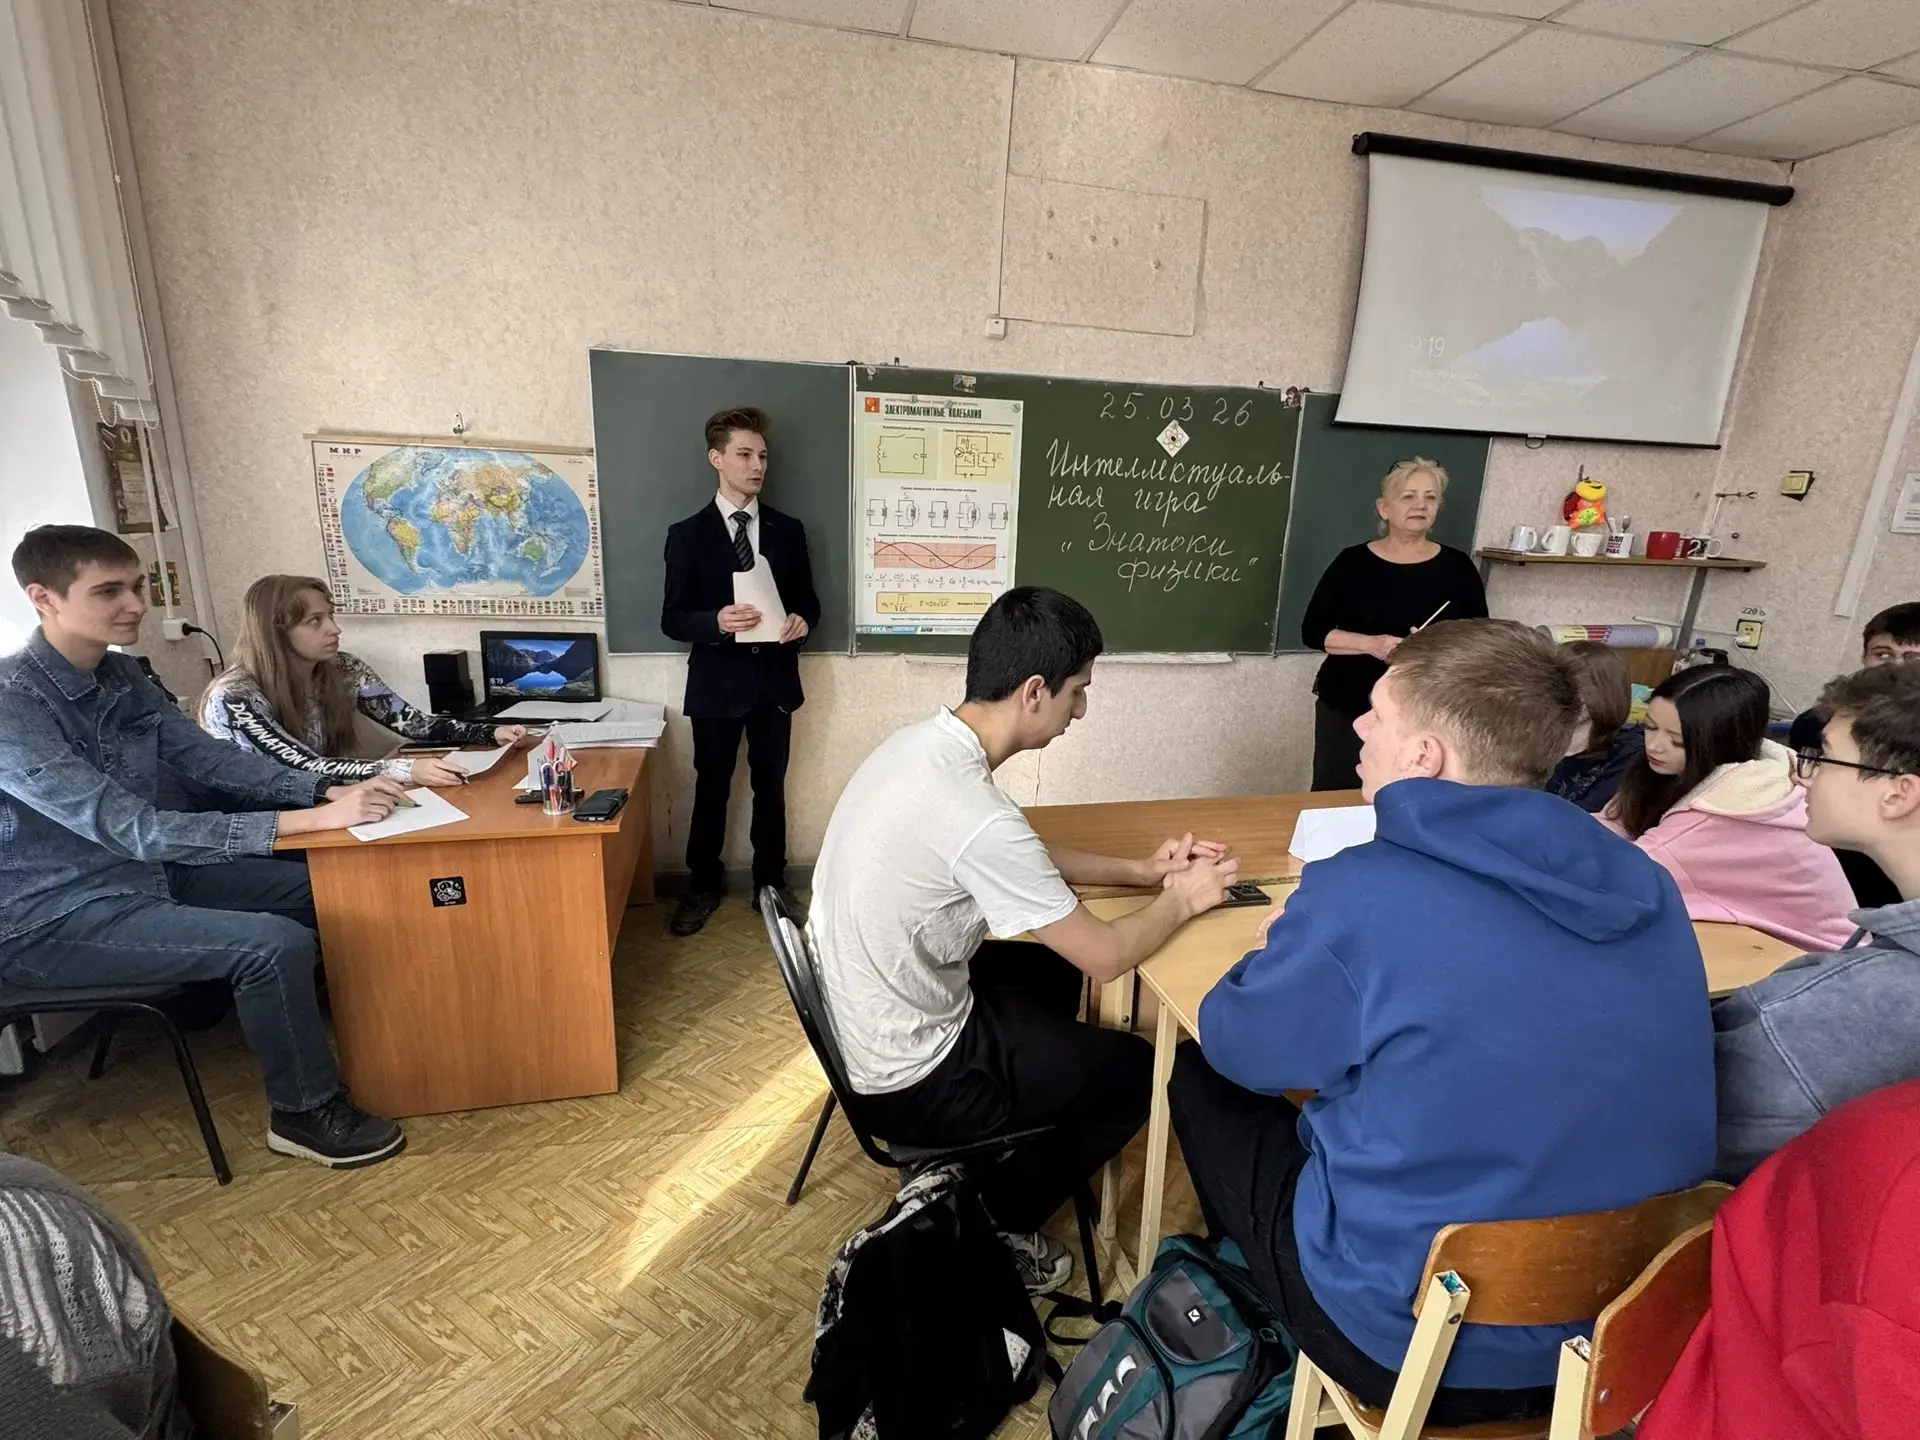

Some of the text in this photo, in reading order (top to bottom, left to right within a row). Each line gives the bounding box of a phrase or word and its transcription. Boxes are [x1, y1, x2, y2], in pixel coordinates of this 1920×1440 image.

[884, 404, 982, 419] ЭЛЕКТРОМАГНИТНЫЕ КОЛЕБАНИЯ
[1048, 484, 1208, 528] ная игра
[225, 702, 377, 776] DOMINATION MACHINE
